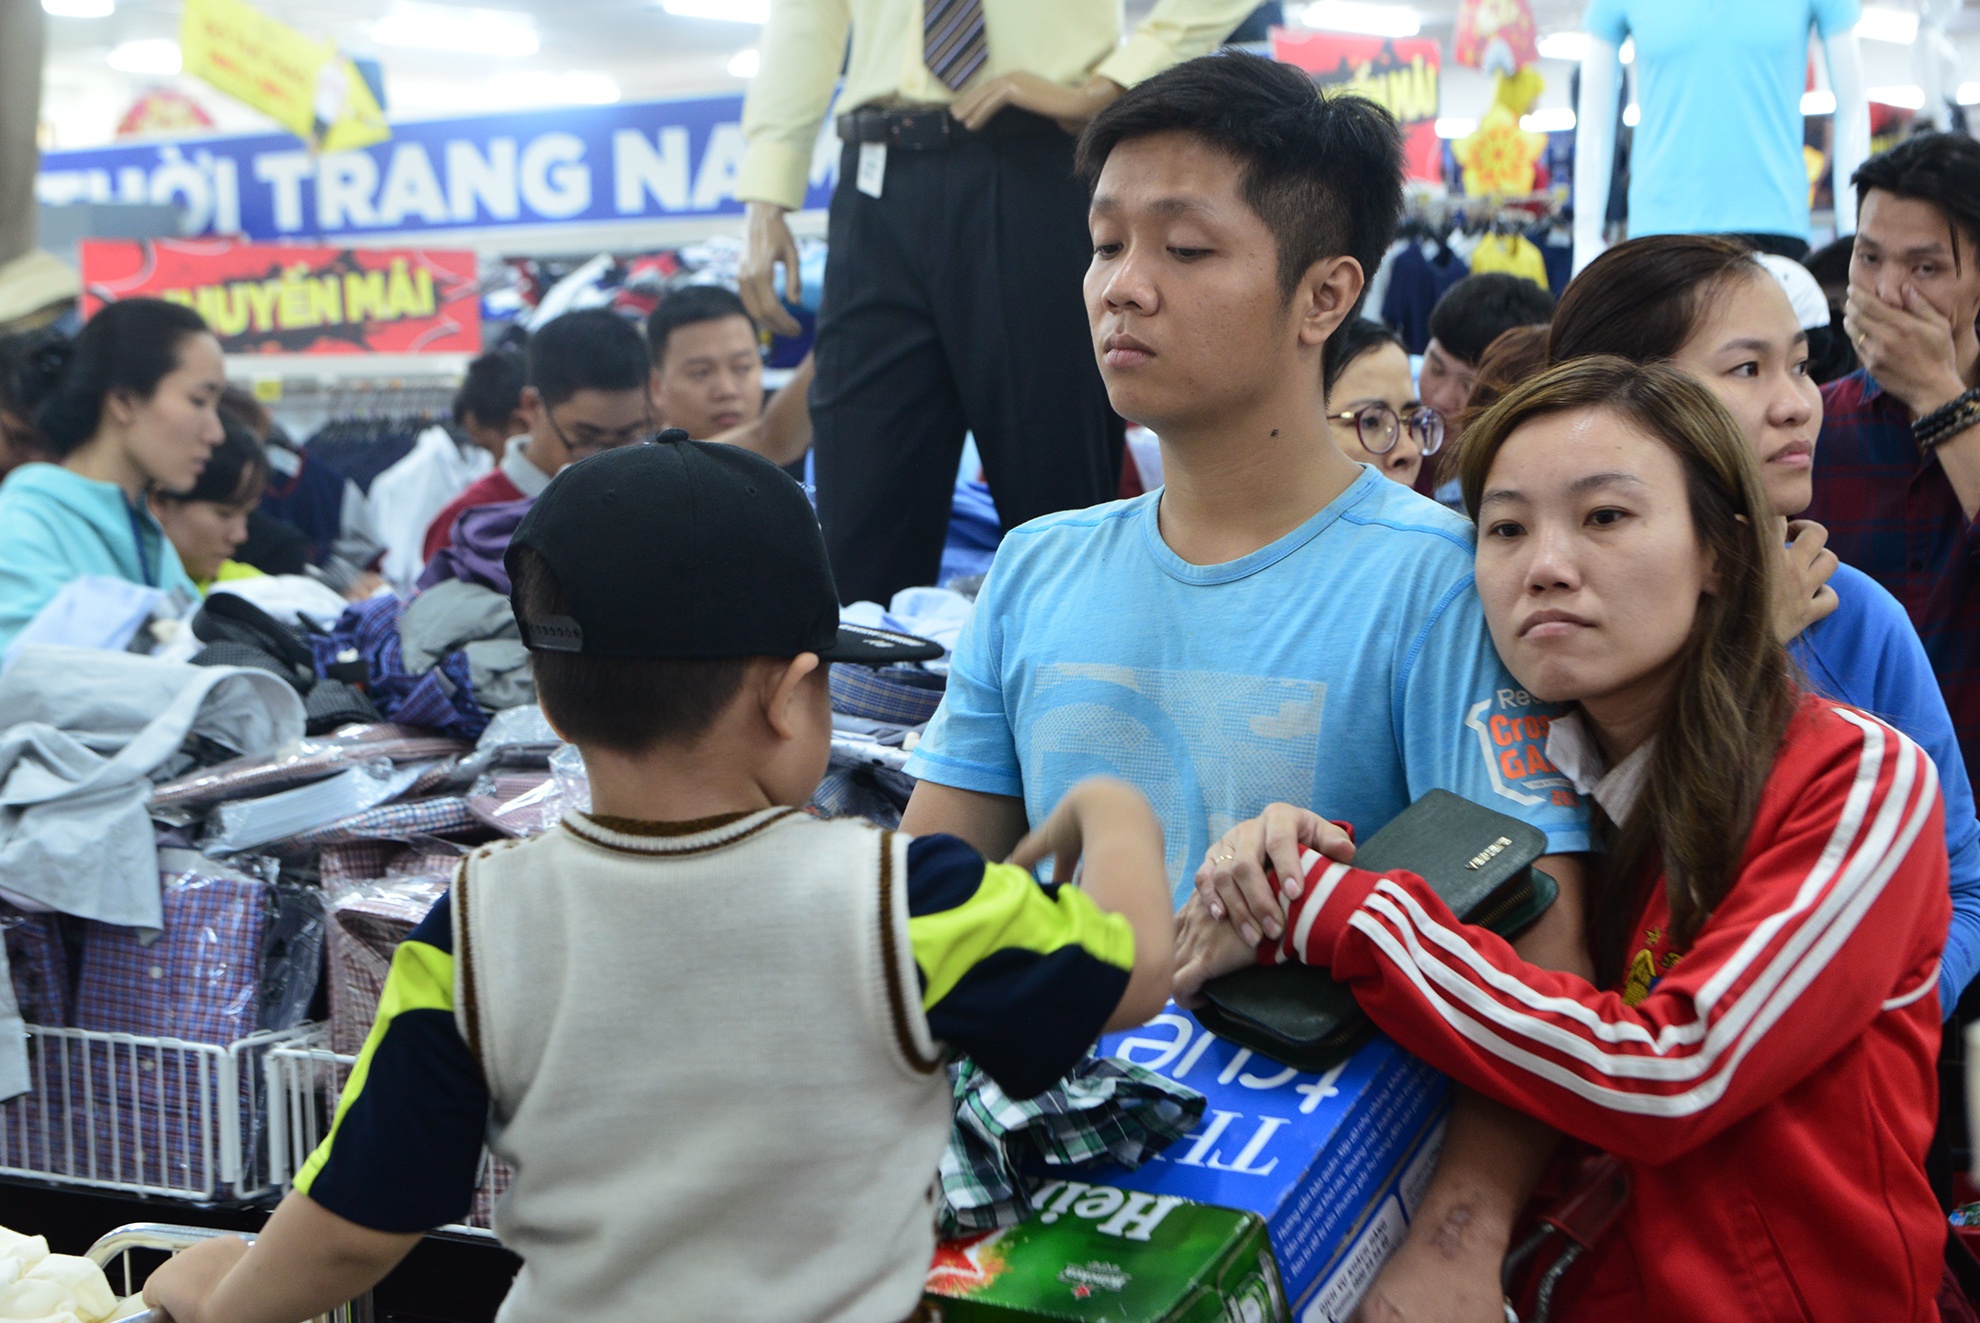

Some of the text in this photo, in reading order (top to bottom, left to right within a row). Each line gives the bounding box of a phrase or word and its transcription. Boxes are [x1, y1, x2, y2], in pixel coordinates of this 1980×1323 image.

[256, 132, 592, 232] TRANG
[1497, 688, 1541, 709] Re
[1489, 714, 1557, 746] Cros
[1499, 745, 1557, 780] GA
